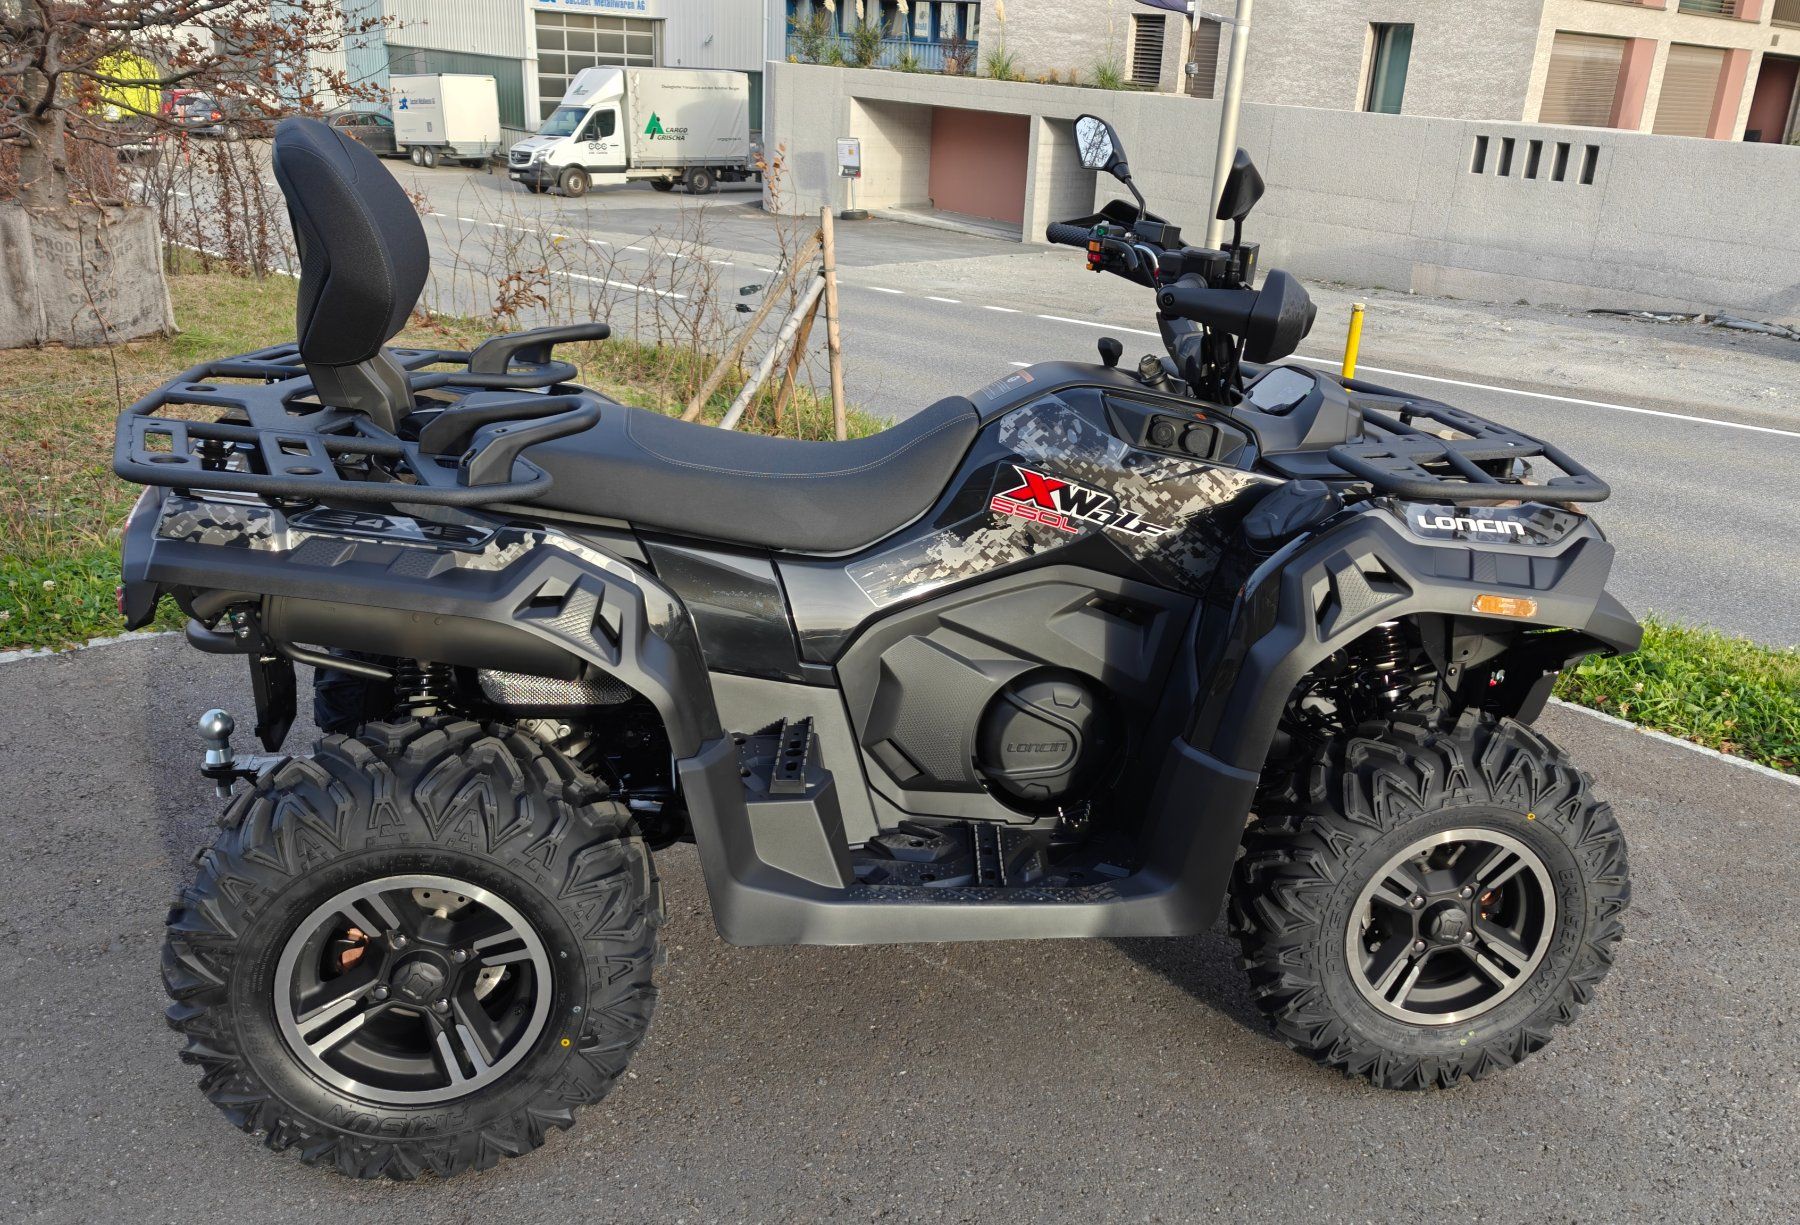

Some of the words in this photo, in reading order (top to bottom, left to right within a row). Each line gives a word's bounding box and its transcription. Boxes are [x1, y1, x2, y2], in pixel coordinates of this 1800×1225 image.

[636, 2, 646, 11] AG
[989, 496, 1079, 534] 550L
[1417, 515, 1525, 536] LONCIN
[1006, 741, 1068, 753] LONCIN
